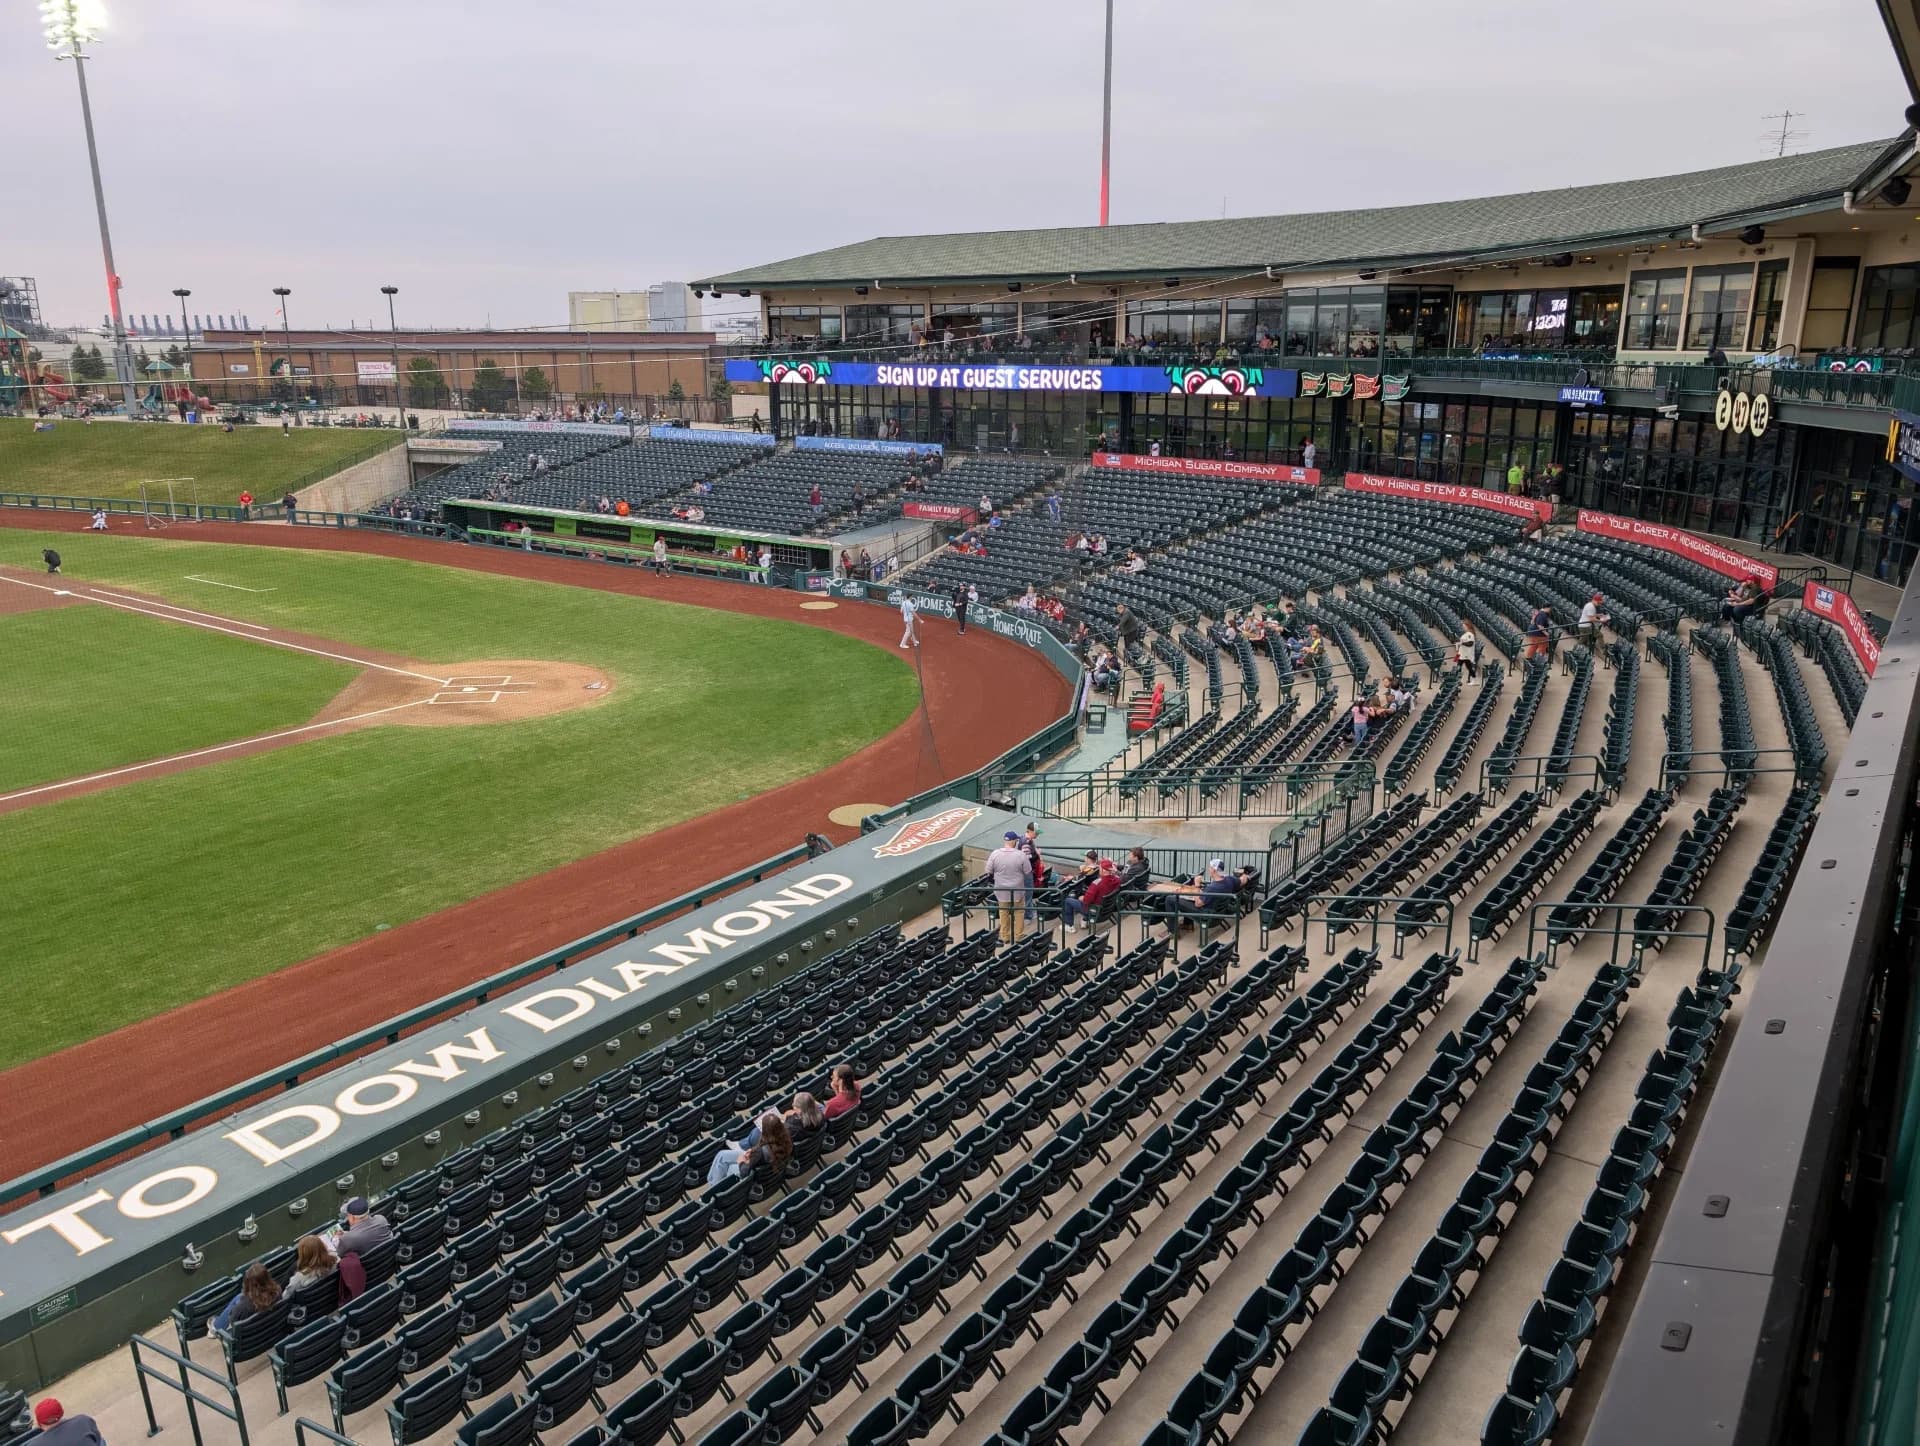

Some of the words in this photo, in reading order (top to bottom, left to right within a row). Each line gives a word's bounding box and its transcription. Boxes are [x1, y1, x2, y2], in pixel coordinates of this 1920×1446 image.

[877, 365, 914, 386] SIGN
[917, 367, 938, 387] UP
[941, 368, 960, 388] AT
[963, 368, 1016, 389] GUEST
[1018, 369, 1103, 390] SERVICES
[1720, 397, 1728, 424] 2
[1735, 399, 1748, 428] 47
[1753, 400, 1767, 430] 42
[1135, 456, 1182, 468] MICHIGAN
[1185, 459, 1222, 472] SUGAR
[1225, 462, 1278, 475] COMPANY
[1362, 476, 1385, 488] NOW
[1388, 479, 1421, 492] HIRING
[1423, 481, 1456, 496] STEM
[1459, 487, 1468, 498] &
[919, 504, 943, 513] FAMILY
[1609, 517, 1630, 531] YOUR
[1633, 522, 1669, 539] CAREER
[911, 595, 944, 612] HOME
[988, 609, 1014, 637] HOME
[1014, 619, 1043, 648] PLATE
[887, 837, 921, 853] DOW
[916, 809, 969, 838] DIAMOND
[2, 1165, 218, 1256] TO
[223, 1026, 507, 1167] DOW
[502, 872, 854, 1034] DIAMOND
[37, 1293, 70, 1312] CAUTION
